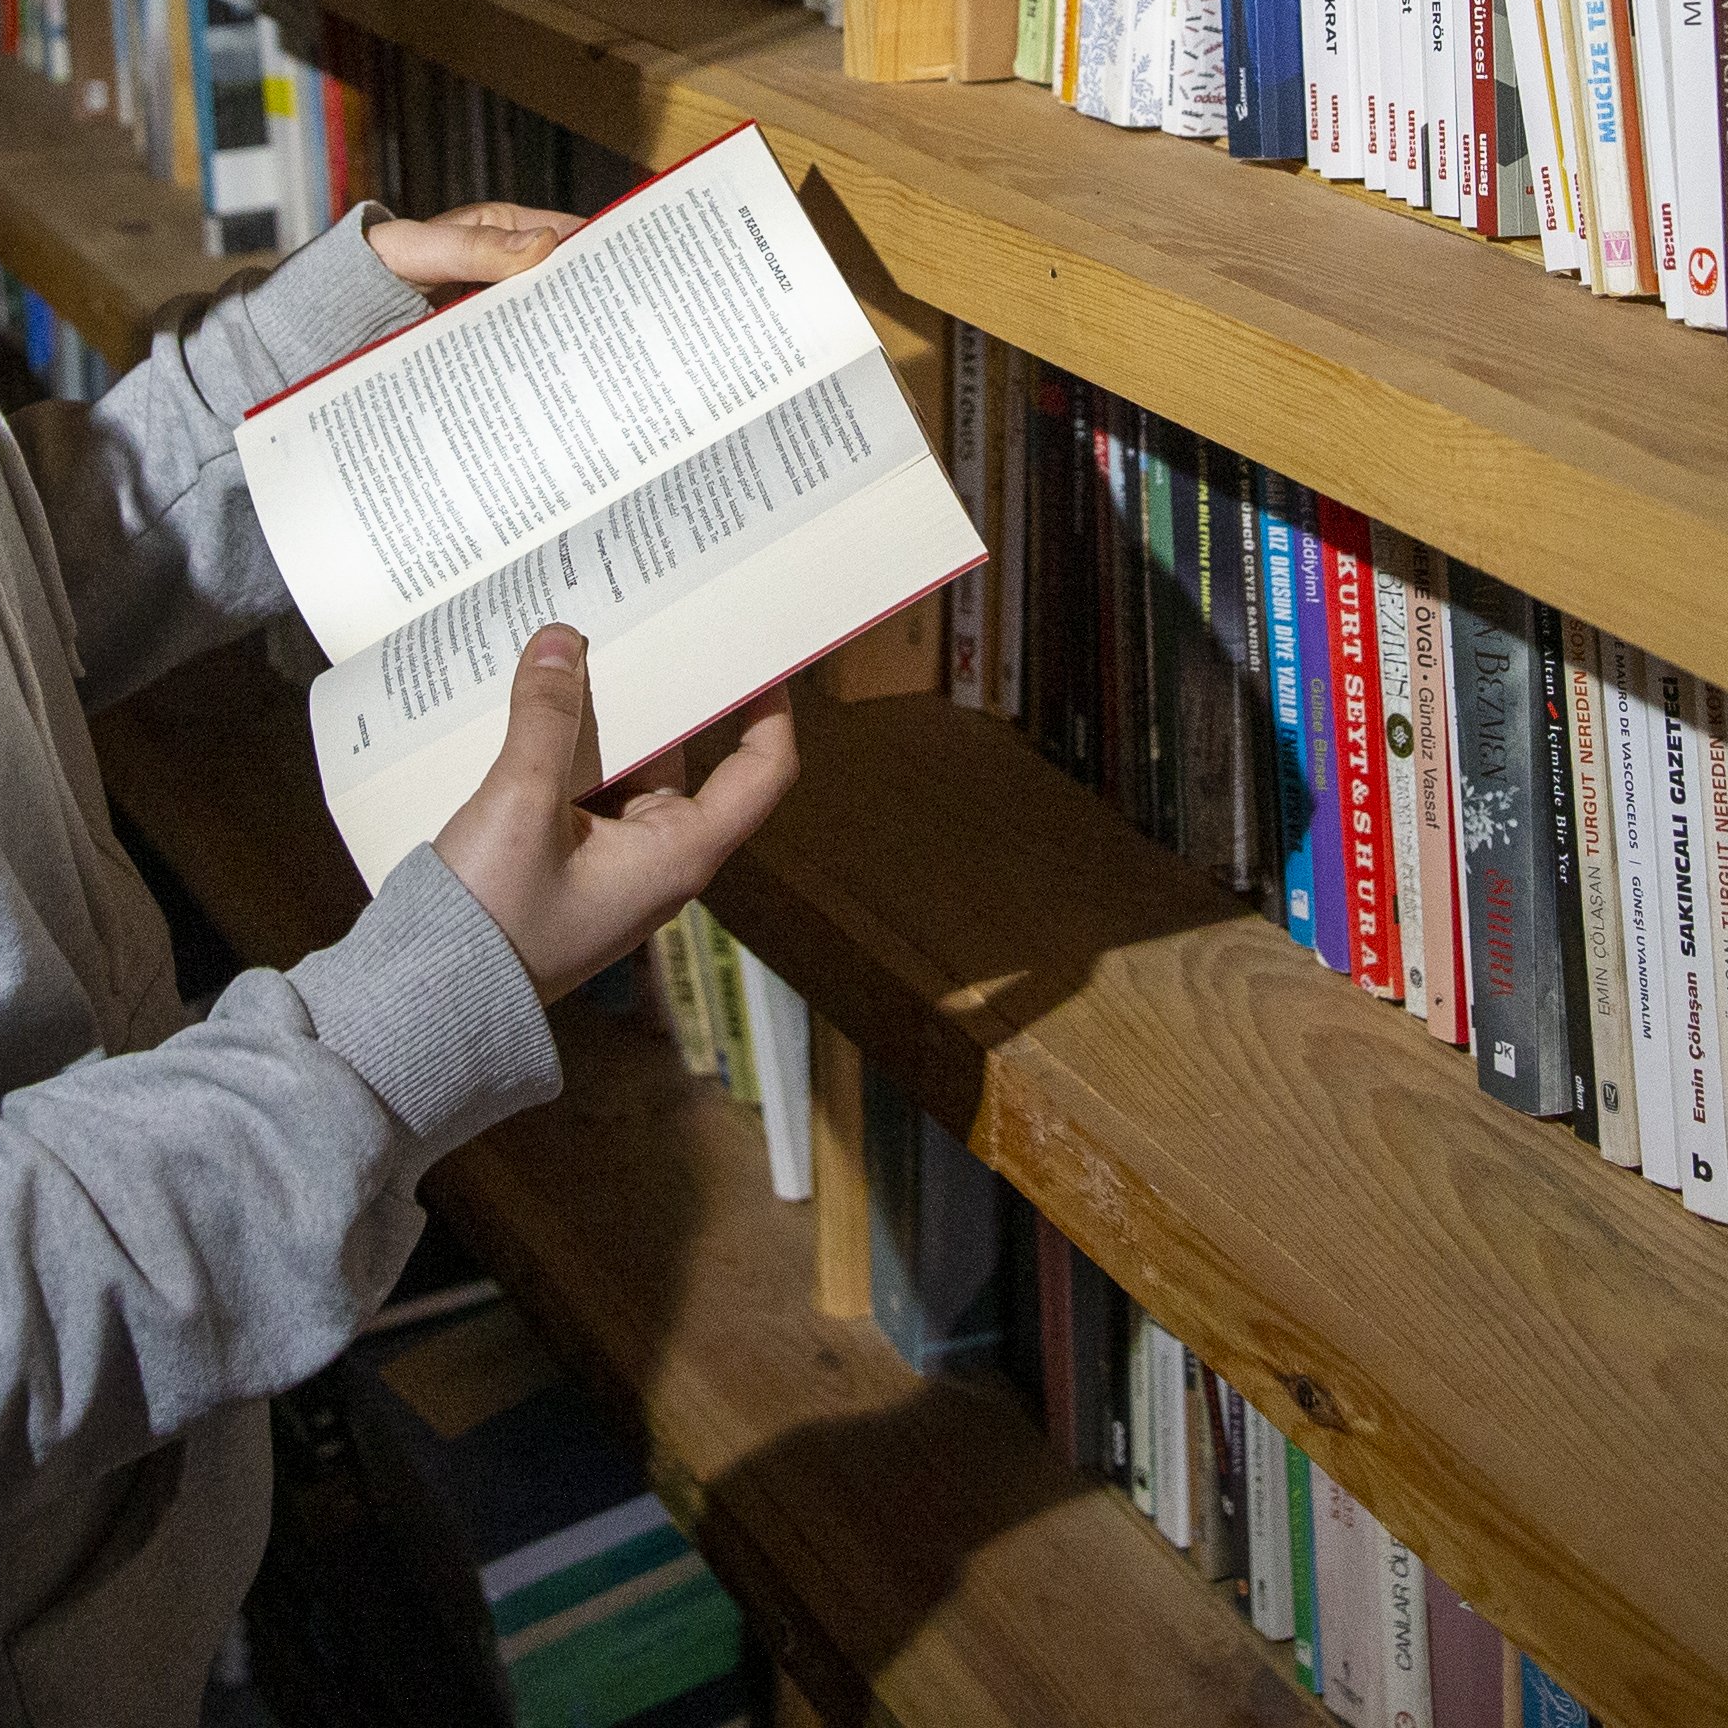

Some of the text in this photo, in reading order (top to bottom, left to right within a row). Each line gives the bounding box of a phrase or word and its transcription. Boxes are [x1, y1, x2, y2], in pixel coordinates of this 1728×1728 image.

[1587, 41, 1618, 144] MUCİZE
[738, 206, 793, 294] BU KADARI OLMAZ!
[1336, 552, 1379, 968] KURT SEYT & SHURA
[1415, 605, 1441, 831] ÖVGÜ Gündüz Vassaf
[1573, 669, 1613, 1017] EMİN ÇÖLAŞAN TURGUT NEREDEN
[1621, 741, 1653, 1040] VASCONCELOS GÜNEŞİ UYANDIRALIM
[1672, 813, 1697, 958] SAKINCALI
[1686, 971, 1703, 1061] Çölaşan
[1691, 1068, 1707, 1124] Emin
